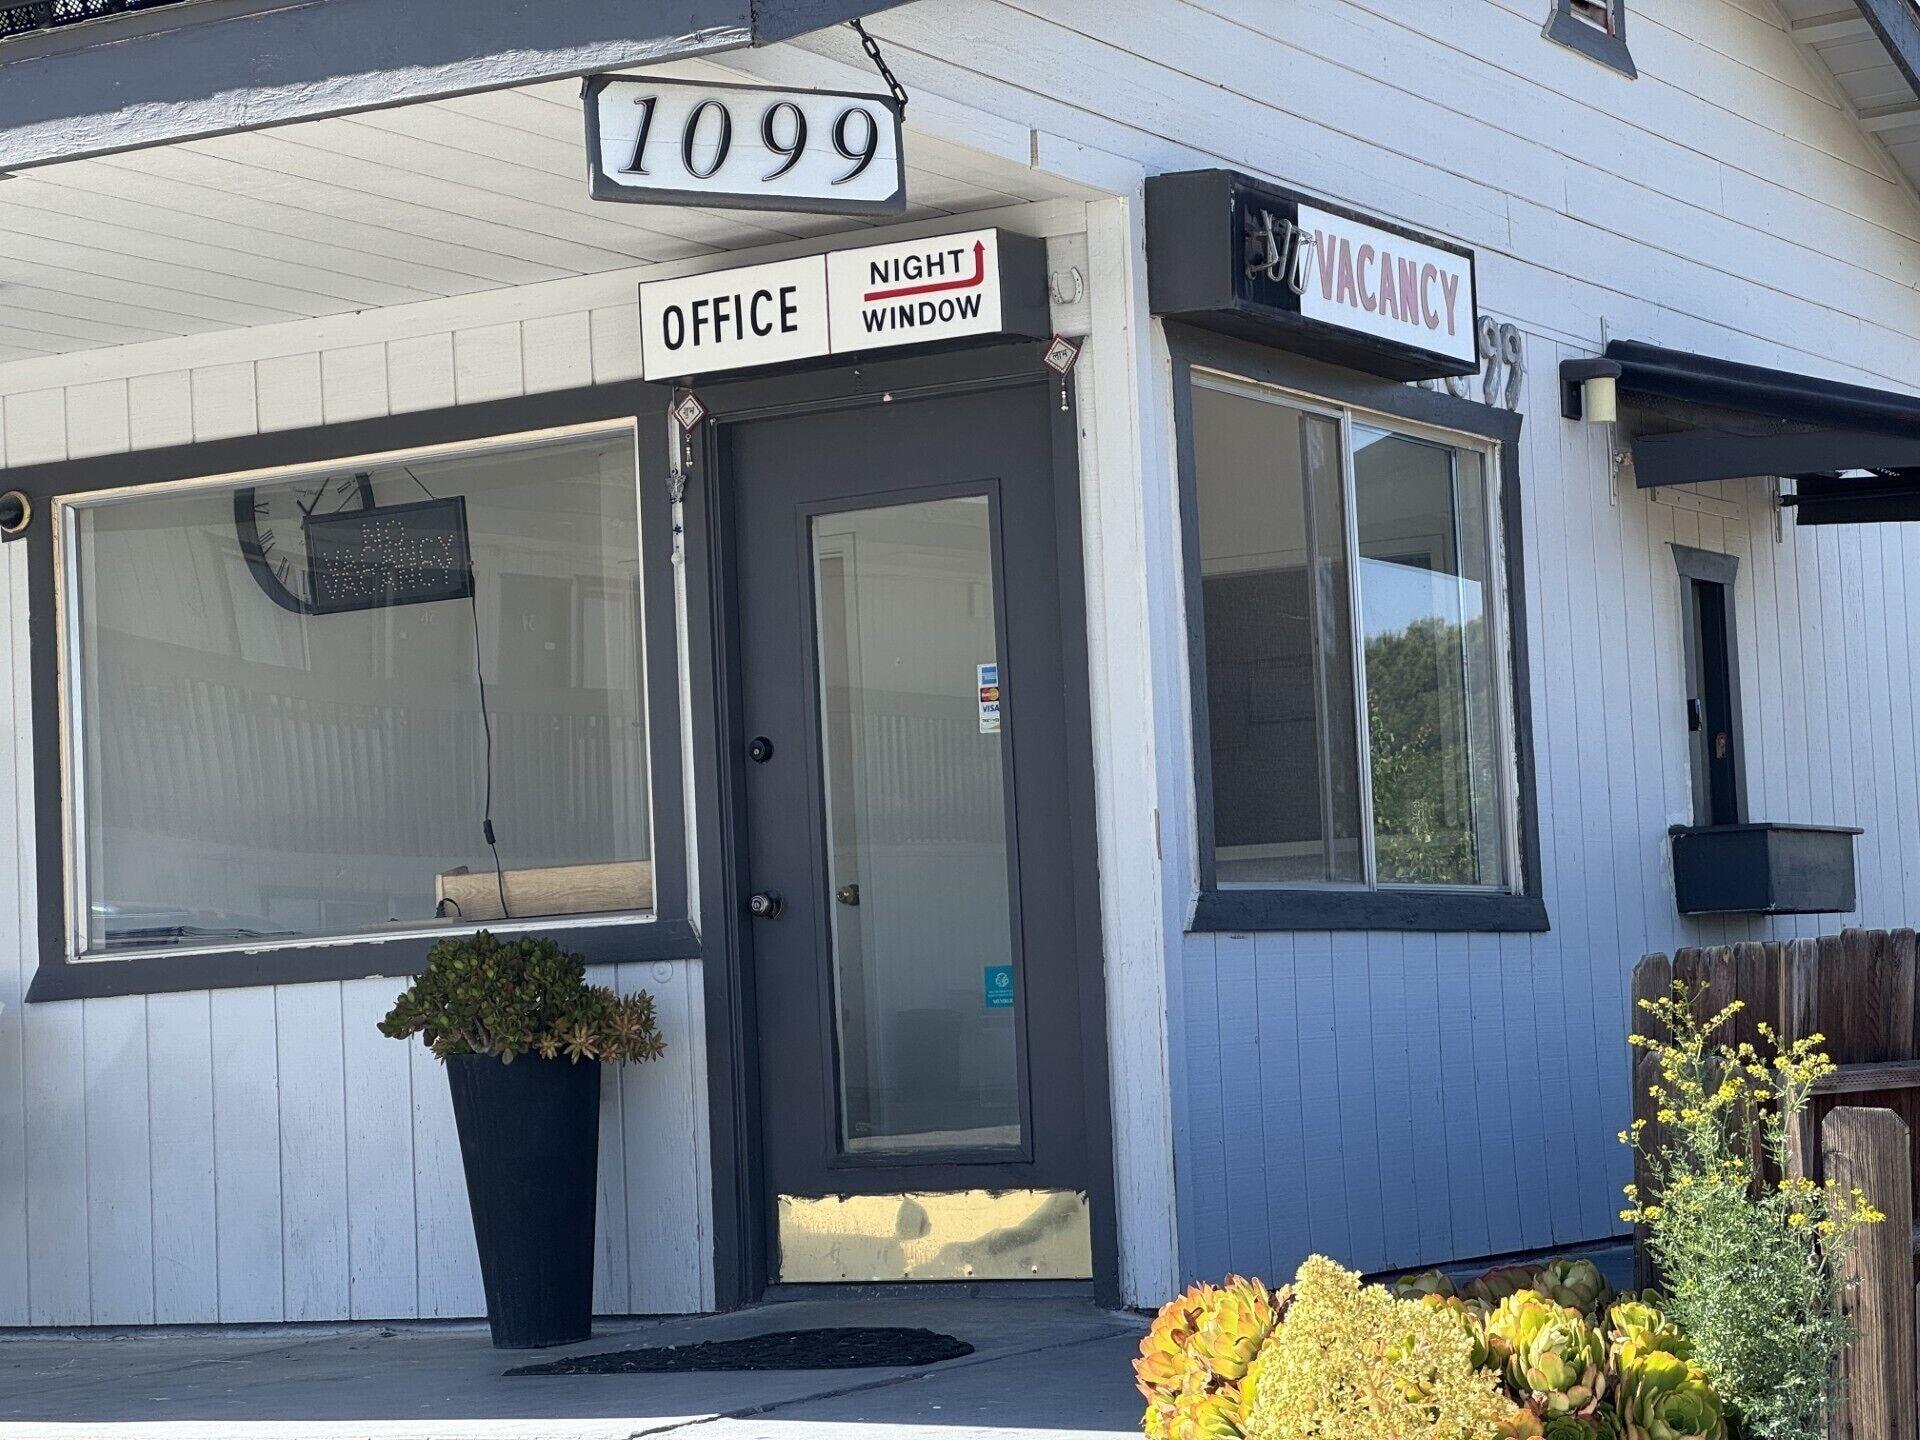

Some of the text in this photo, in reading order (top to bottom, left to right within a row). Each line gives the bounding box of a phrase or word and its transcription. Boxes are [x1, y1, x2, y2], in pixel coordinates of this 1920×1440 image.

[618, 95, 879, 185] 1099
[869, 248, 966, 285] NIGHT
[1314, 229, 1460, 336] VACANCY
[662, 285, 799, 352] OFFICE
[862, 294, 983, 333] WINDOW
[982, 704, 1000, 713] VISA
